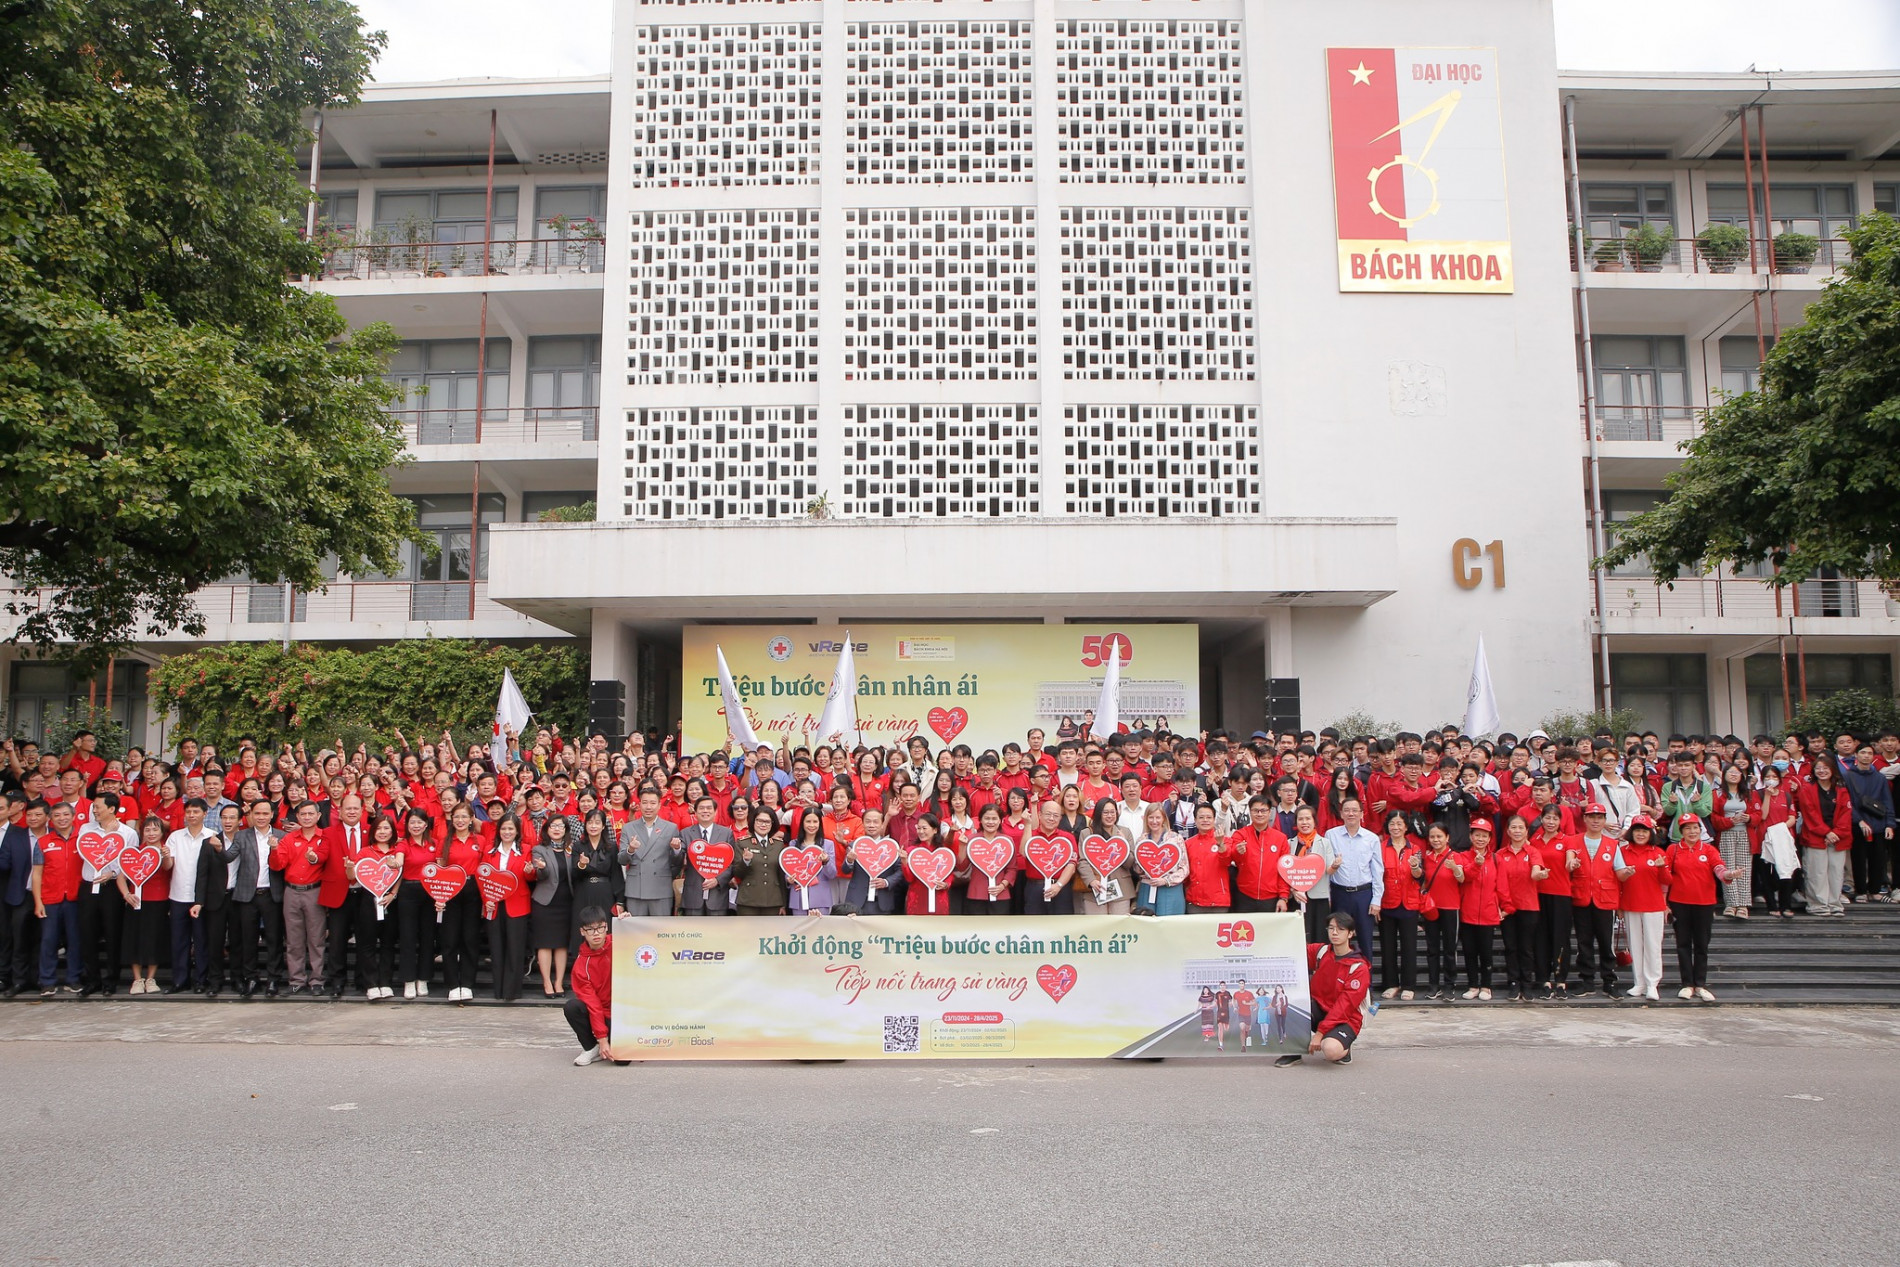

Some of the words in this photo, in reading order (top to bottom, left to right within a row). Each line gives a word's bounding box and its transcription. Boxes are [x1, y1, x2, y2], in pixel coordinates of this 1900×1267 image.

[1412, 63, 1442, 84] ĐẠI
[1447, 63, 1482, 84] HỌC
[1350, 247, 1422, 280] BÁCH
[1430, 254, 1502, 281] KHOA
[1451, 537, 1506, 590] C1
[702, 675, 765, 703] Tiệu
[771, 673, 825, 696] bước
[892, 674, 951, 696] nhân
[957, 673, 978, 696] ái
[767, 712, 797, 731] nối
[877, 714, 919, 743] vàng
[758, 934, 807, 955] Khởi
[811, 934, 863, 960] động
[867, 933, 936, 960] “Triệu
[941, 933, 991, 955] bước
[995, 934, 1045, 955] chân
[1050, 934, 1104, 955] nhân
[1108, 933, 1139, 955] ái”
[1216, 920, 1255, 948] 50
[671, 949, 726, 961] vRace
[824, 963, 871, 1006] Tiếp
[875, 970, 905, 990] nối
[910, 971, 957, 1002] trang
[961, 972, 985, 990] sử
[986, 972, 1028, 1002] vàng
